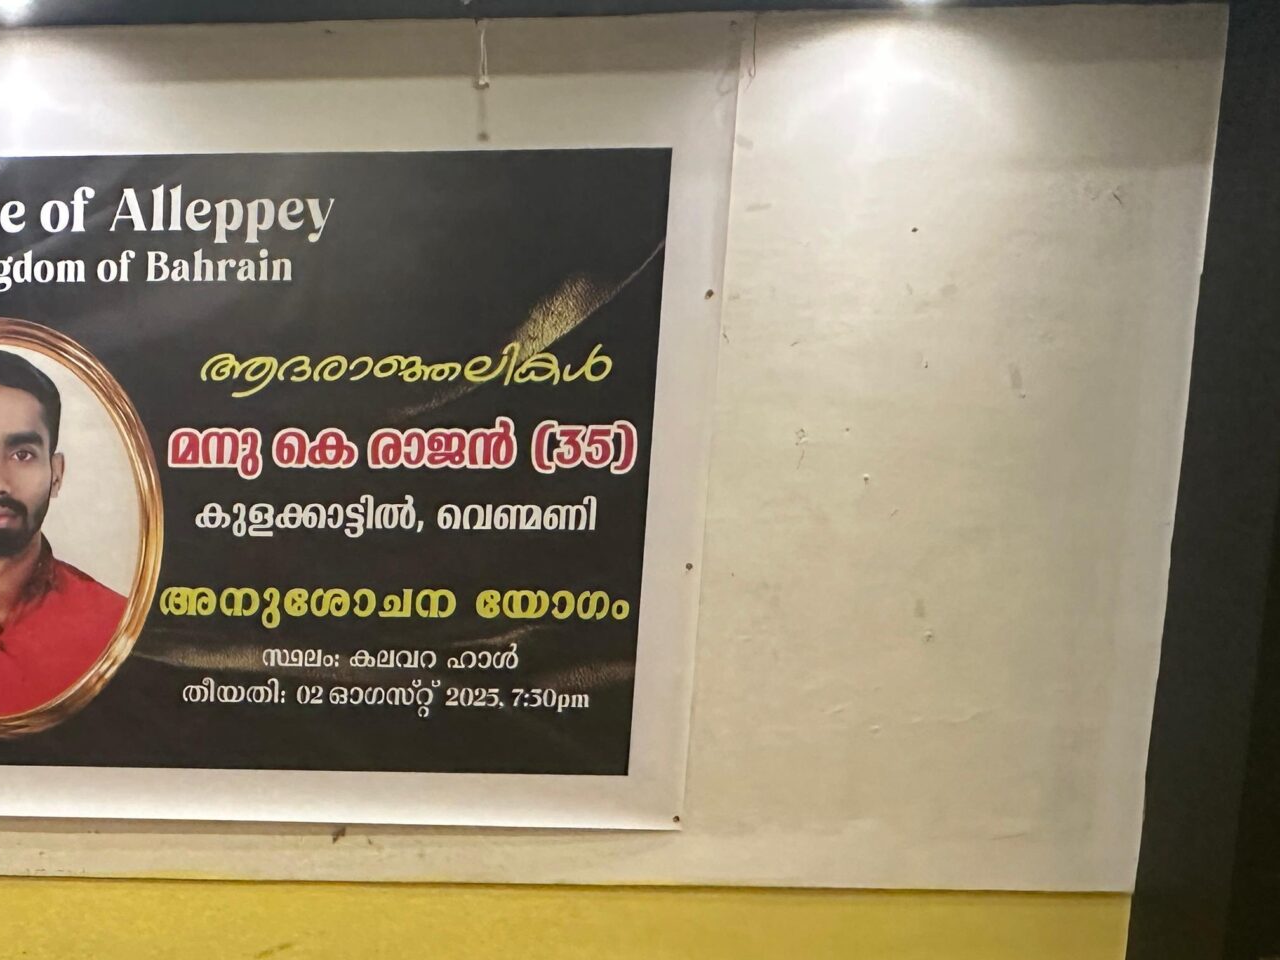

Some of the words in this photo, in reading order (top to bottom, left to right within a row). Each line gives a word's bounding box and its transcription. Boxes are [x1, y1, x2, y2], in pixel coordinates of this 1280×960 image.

[39, 185, 96, 233] of
[109, 183, 335, 244] Alleppey
[96, 249, 136, 283] of
[146, 248, 293, 282] Bahrain
[167, 427, 263, 480] മനു
[272, 427, 359, 470] കെ
[367, 416, 518, 470] രാജൻ
[531, 419, 638, 475] (35)
[159, 585, 457, 629] അനുശോചന
[475, 588, 631, 621] യോഗം
[262, 648, 340, 668] സ്ഥലം:
[349, 649, 437, 669] കലവറ
[447, 642, 519, 669] ഹാൾ
[182, 678, 286, 704] തീയതി:
[296, 685, 324, 705] 02
